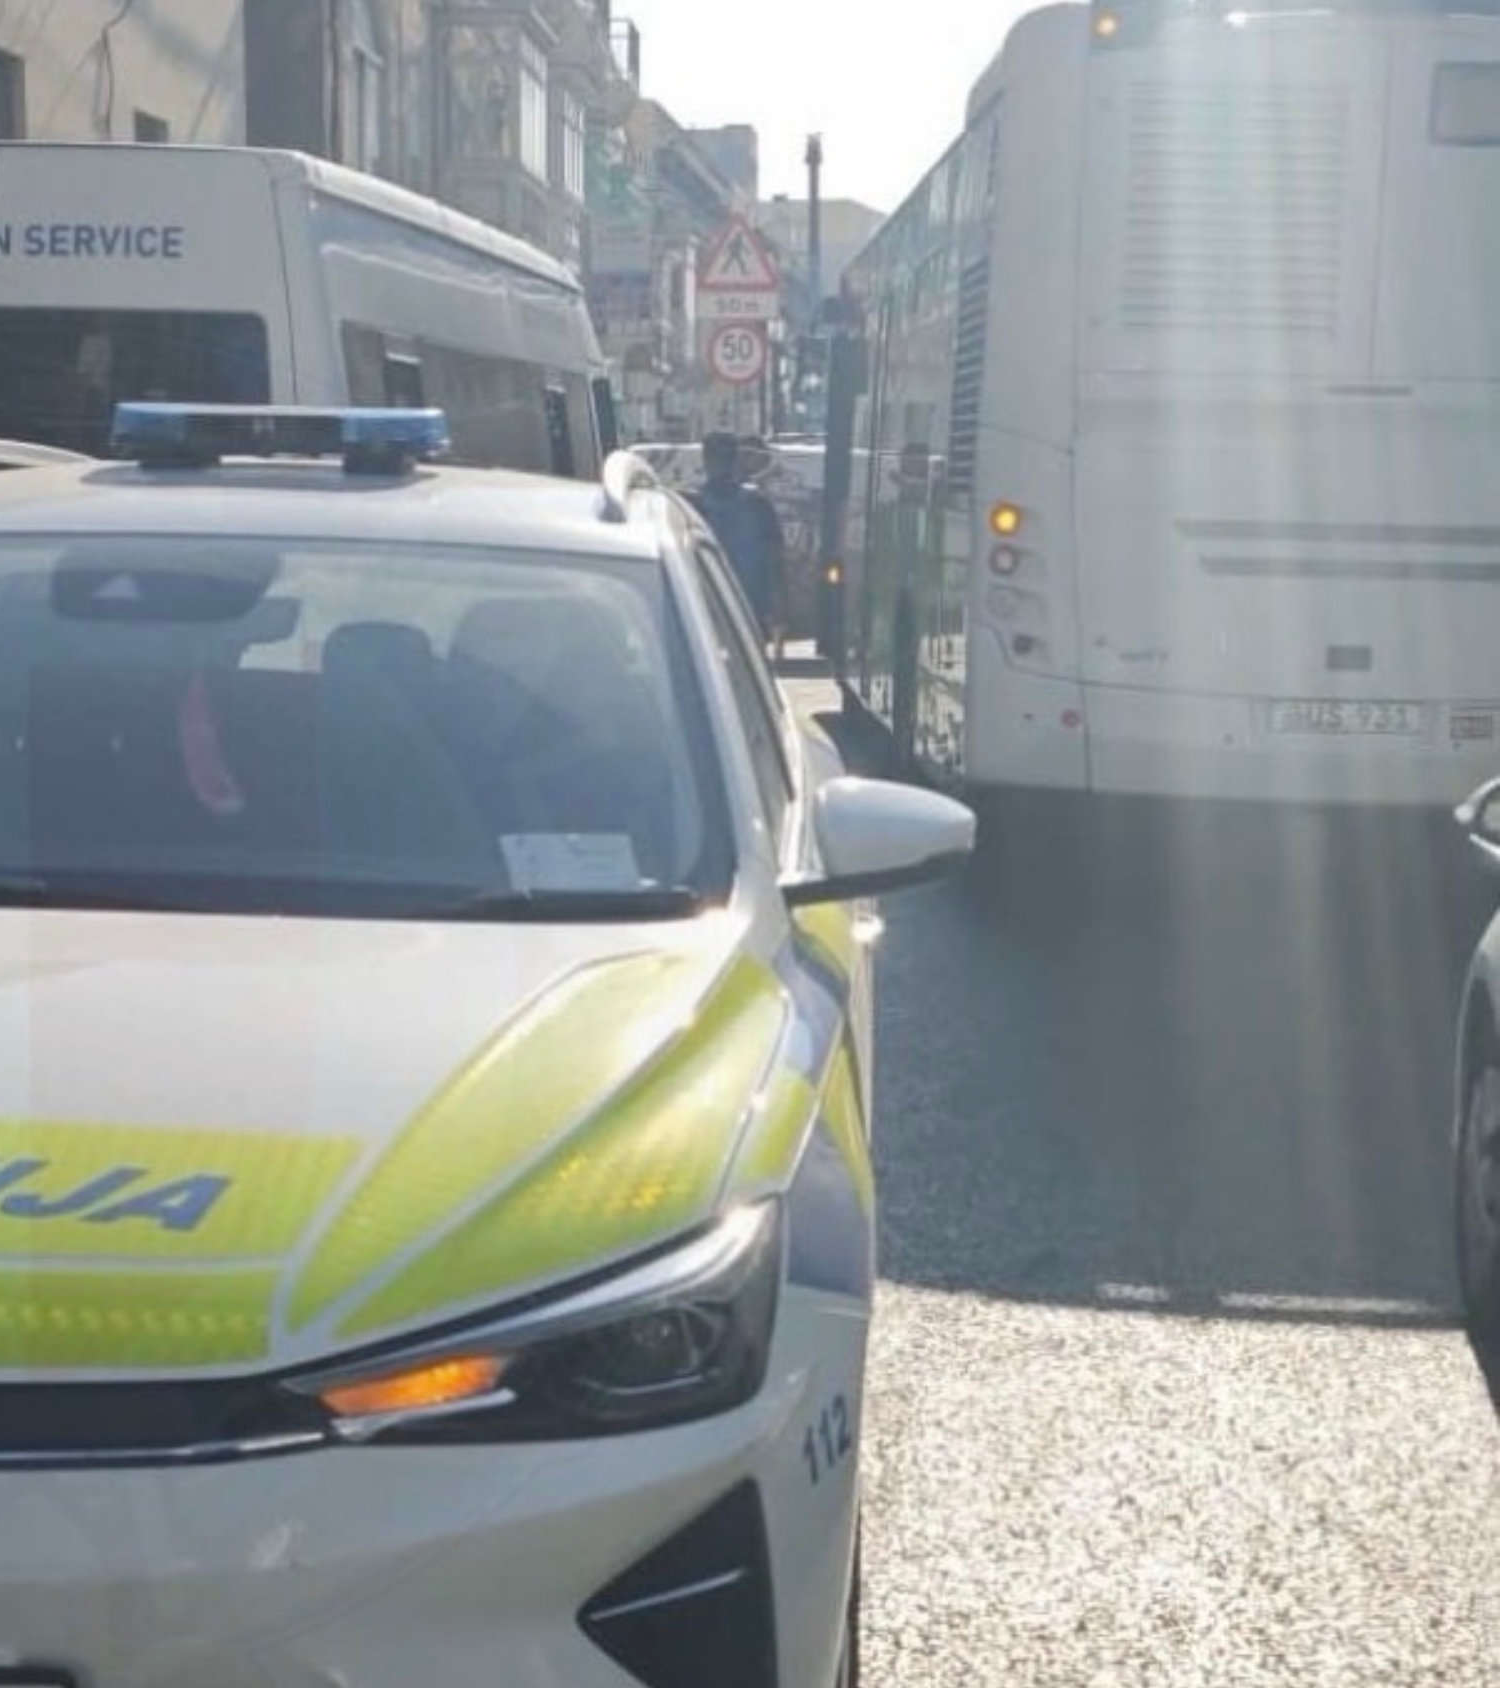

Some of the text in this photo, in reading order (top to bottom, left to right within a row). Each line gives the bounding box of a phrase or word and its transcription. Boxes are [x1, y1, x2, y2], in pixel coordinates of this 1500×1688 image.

[23, 225, 185, 257] SERVICE
[721, 333, 755, 361] 50
[803, 1393, 852, 1485] 112
